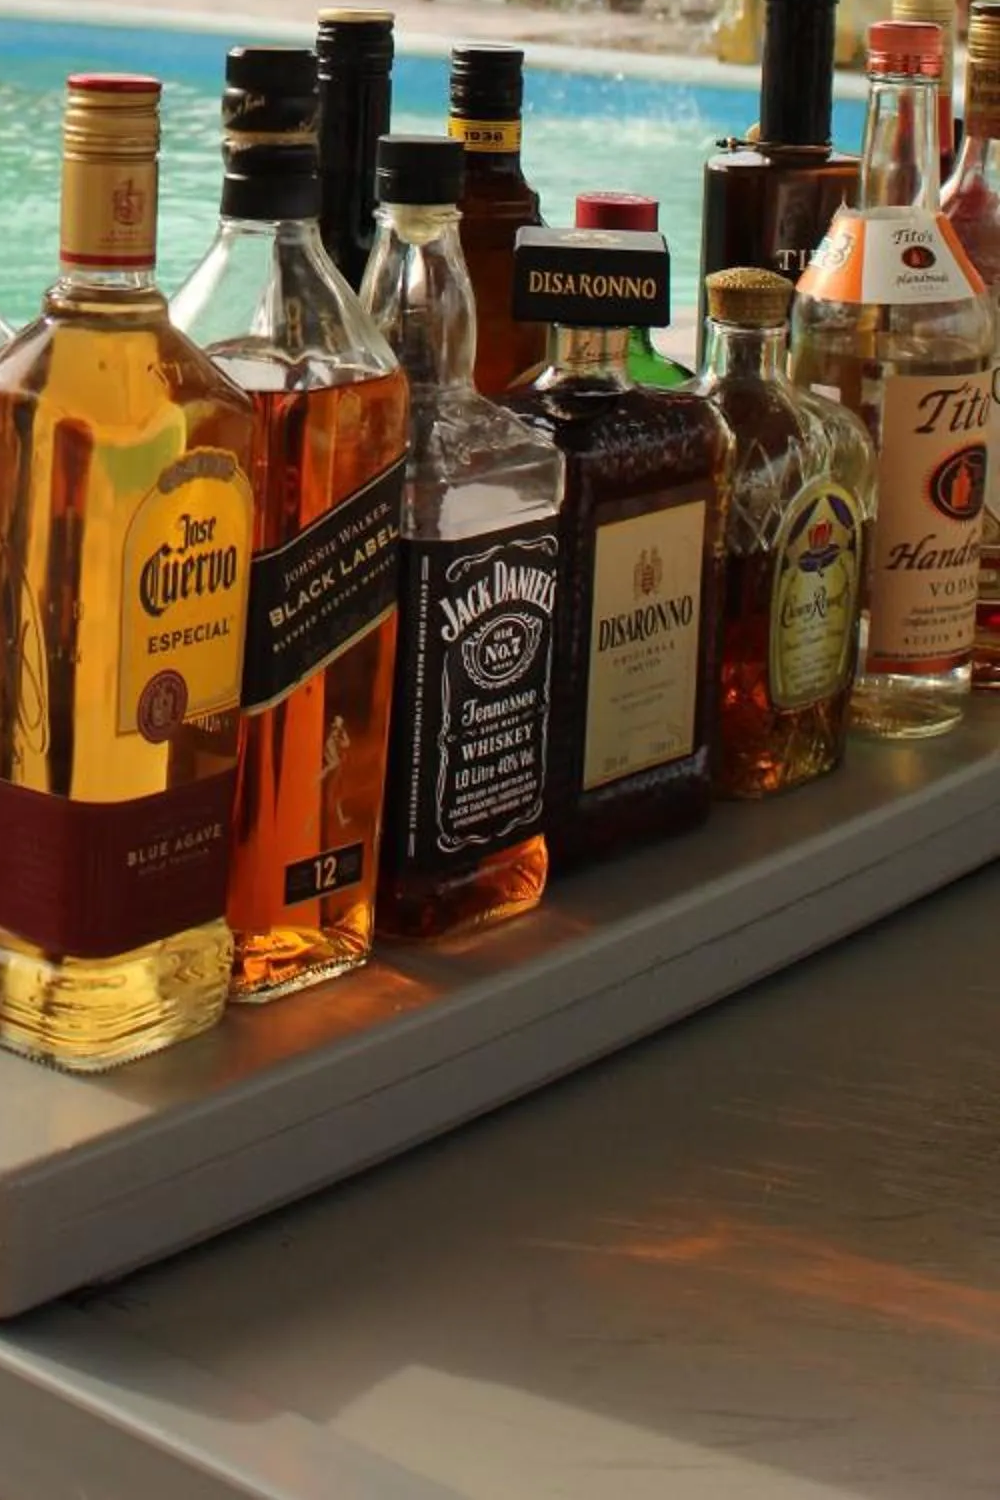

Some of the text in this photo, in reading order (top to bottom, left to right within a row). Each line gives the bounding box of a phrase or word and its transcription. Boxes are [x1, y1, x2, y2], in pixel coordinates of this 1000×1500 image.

[892, 228, 936, 246] Tito's
[775, 248, 807, 271] TI
[528, 270, 658, 300] DISARONNO
[176, 512, 217, 555] Jose
[282, 501, 391, 591] JOHNNIE WALKER
[138, 541, 239, 619] Cuervo
[267, 523, 400, 629] BLACK LABEL
[438, 575, 494, 642] JACK
[597, 594, 694, 653] DISARONNO
[147, 618, 231, 655] ESPECIAL
[460, 688, 538, 728] Tennessee
[460, 722, 535, 762] WHISKEY
[126, 839, 170, 869] BLUE
[174, 822, 224, 853] AGAVE
[313, 855, 338, 891] 12
